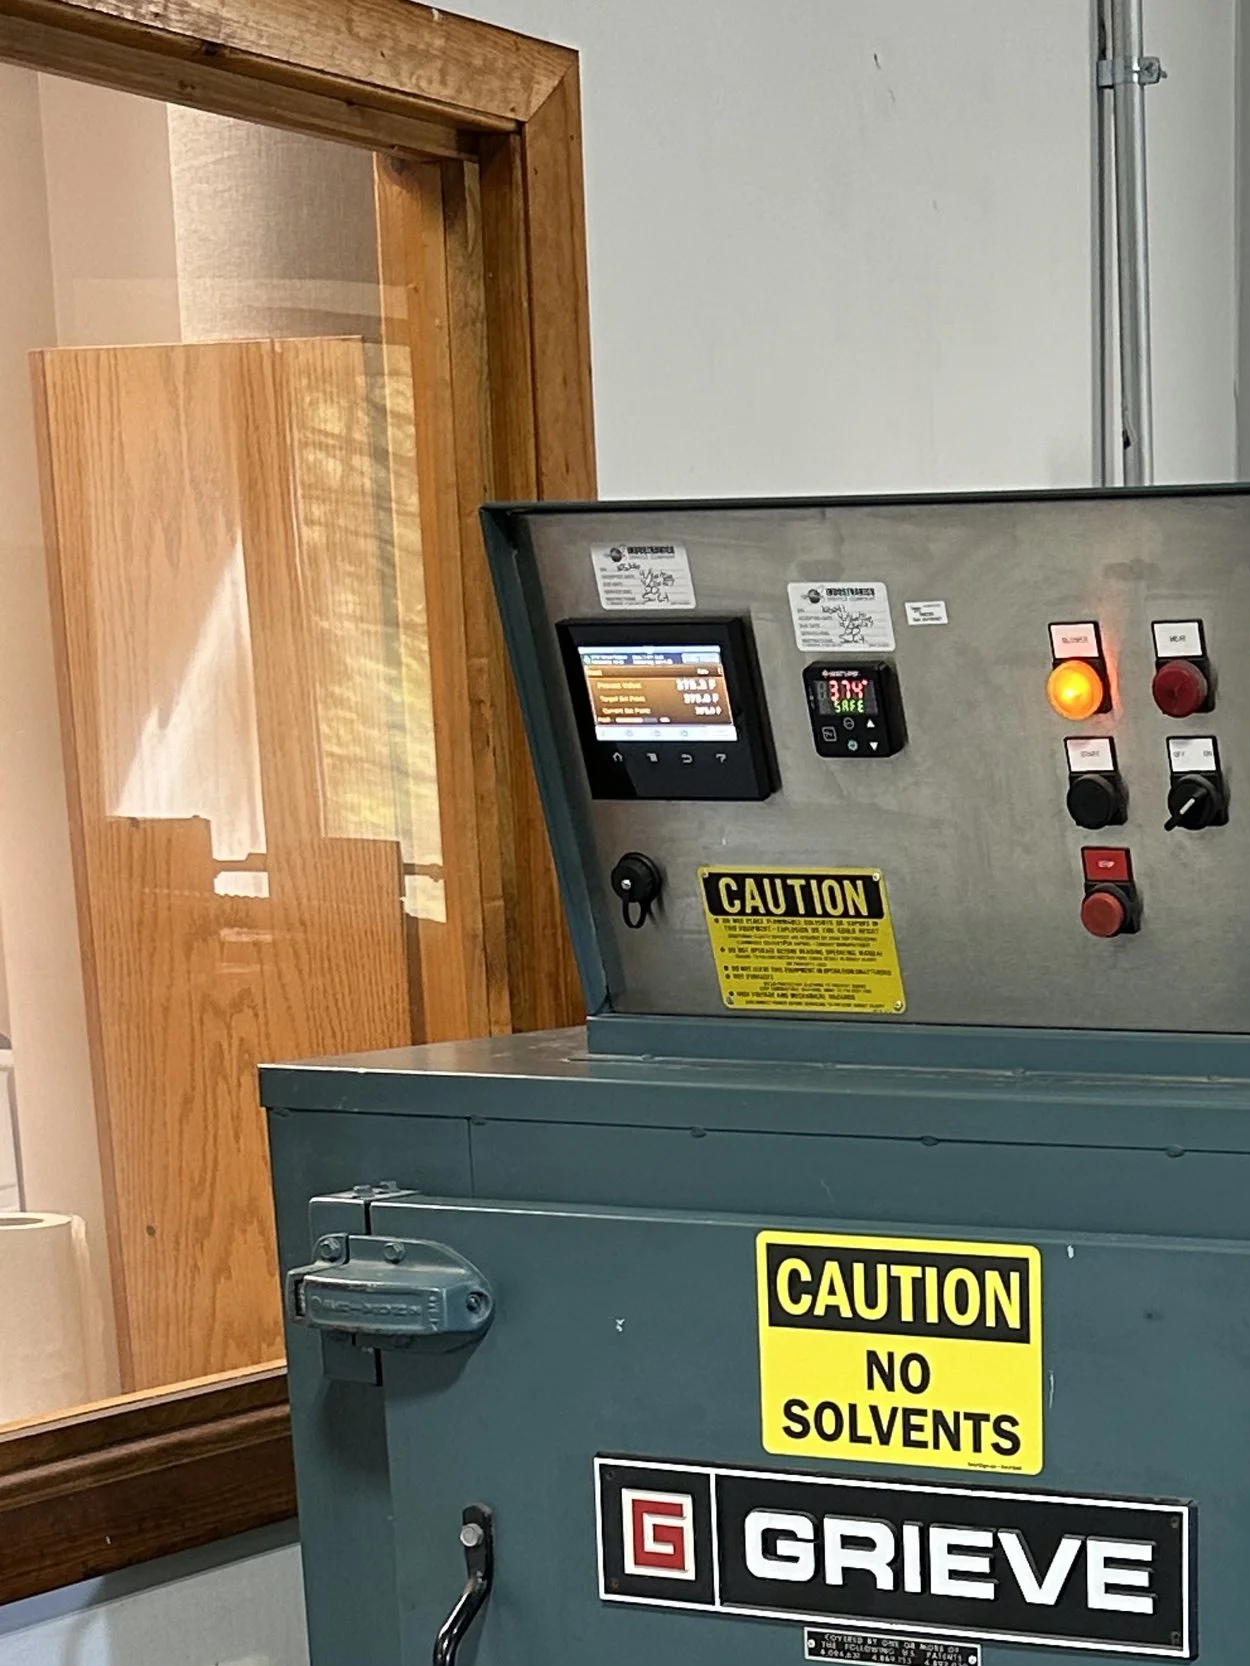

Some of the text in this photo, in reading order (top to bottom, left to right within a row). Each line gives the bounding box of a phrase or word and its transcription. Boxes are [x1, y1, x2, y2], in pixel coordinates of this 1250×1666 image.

[834, 699, 865, 713] SAFE
[718, 876, 868, 916] CAUTION
[776, 1258, 1021, 1329] CAUTION
[866, 1350, 931, 1394] NO
[782, 1398, 1022, 1456] SOLVENTS
[744, 1507, 1156, 1615] GRIEVE
[820, 1640, 837, 1649] THE
[844, 1643, 895, 1655] FOLLOWING
[926, 1652, 963, 1662] PATENTS
[824, 1633, 863, 1644] COVERED
[919, 1643, 944, 1652] MORE
